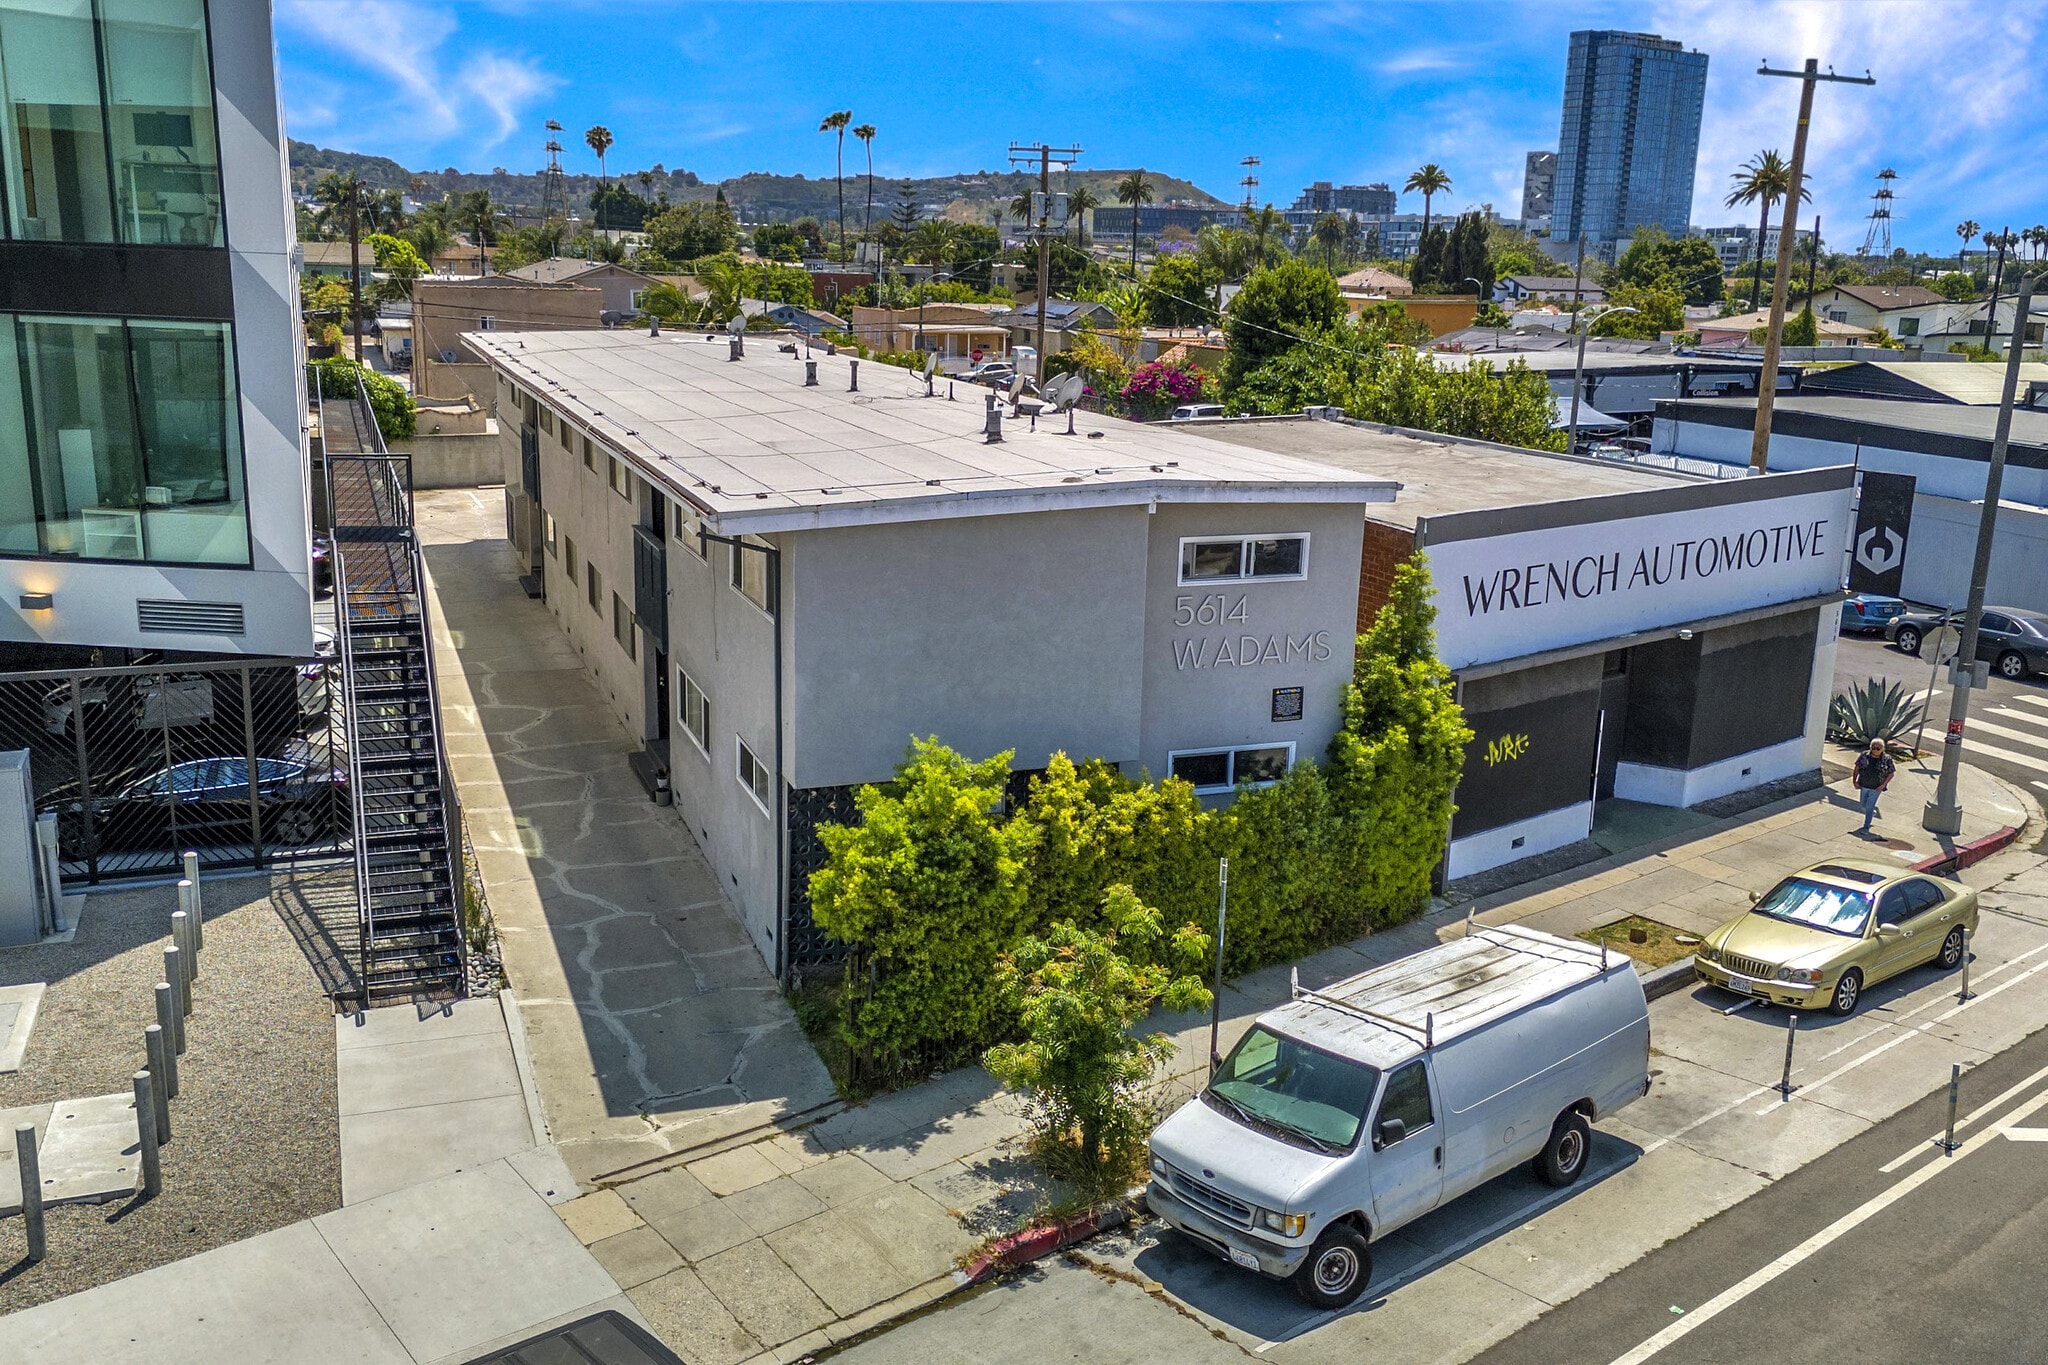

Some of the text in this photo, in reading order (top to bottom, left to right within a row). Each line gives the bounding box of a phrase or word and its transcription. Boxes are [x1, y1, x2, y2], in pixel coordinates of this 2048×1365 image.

[1463, 520, 1829, 617] WRENCH AUTOMOTIVE
[1174, 594, 1250, 627] 5614
